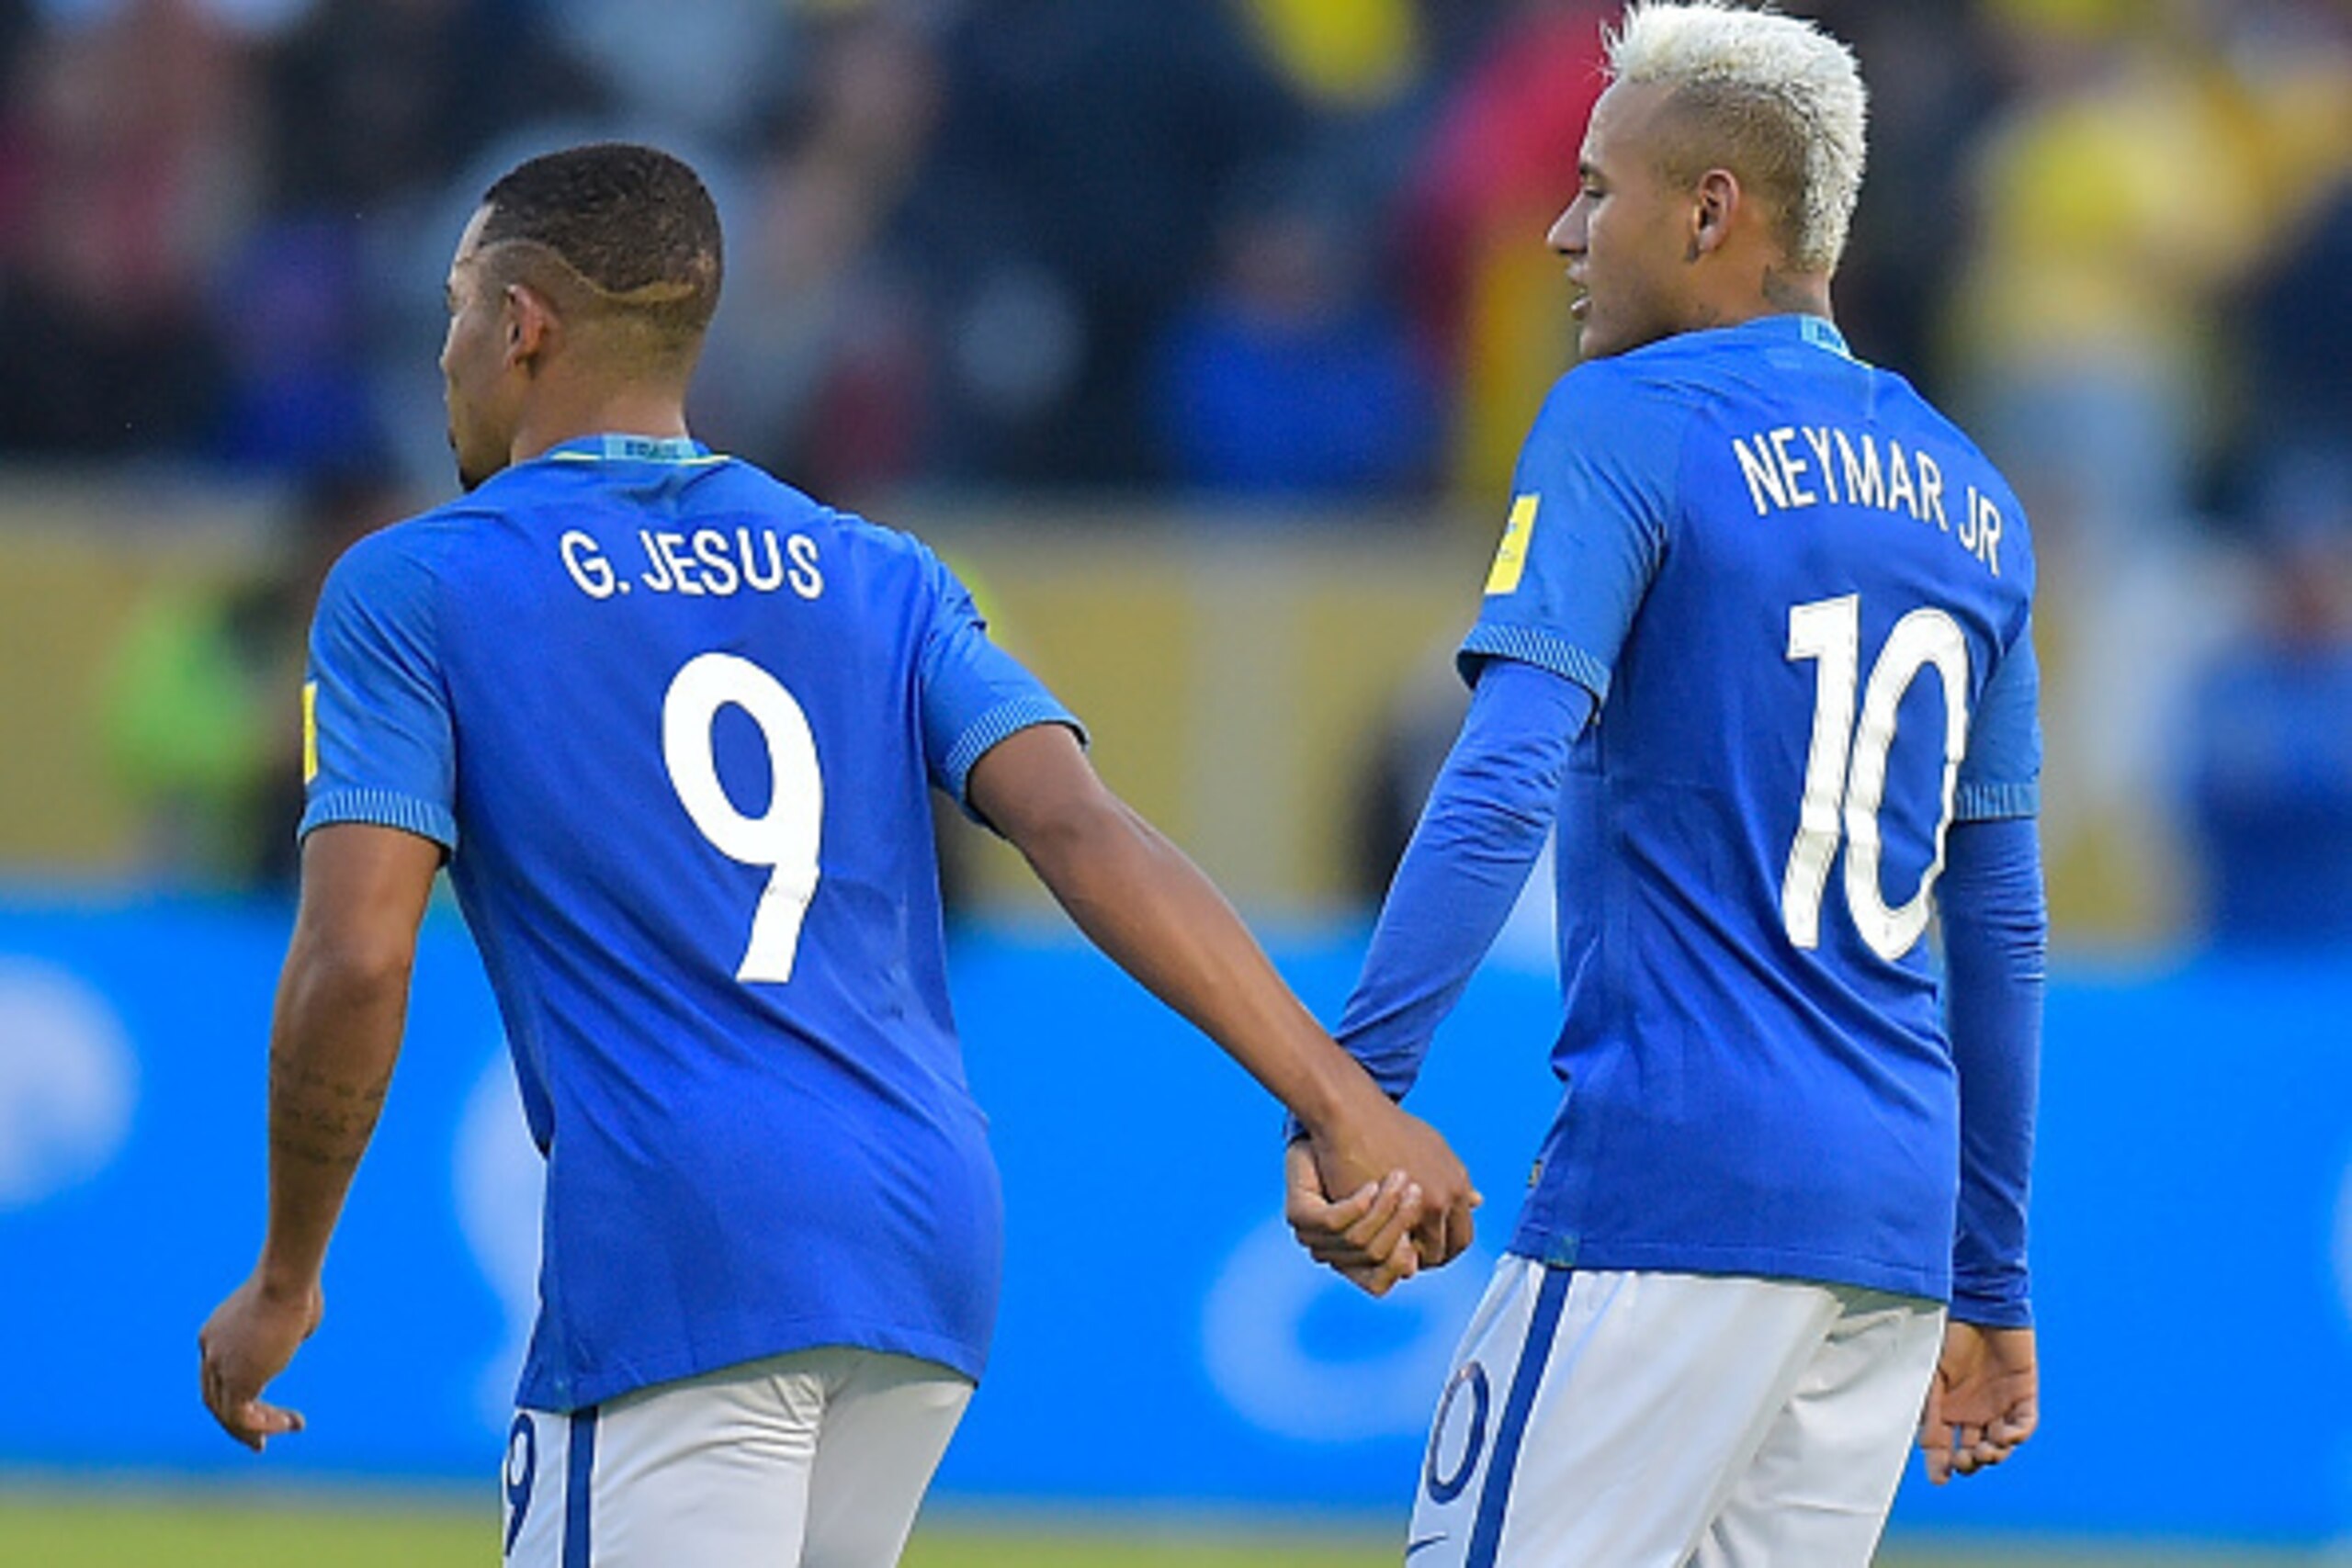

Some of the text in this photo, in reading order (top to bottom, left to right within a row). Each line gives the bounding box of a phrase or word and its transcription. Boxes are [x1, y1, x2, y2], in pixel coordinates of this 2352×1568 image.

[560, 528, 823, 599] G. JESUS
[1733, 426, 2003, 576] NEYMAR JR
[662, 653, 824, 984] 9
[1781, 593, 1969, 964] 10
[505, 1413, 536, 1557] 9
